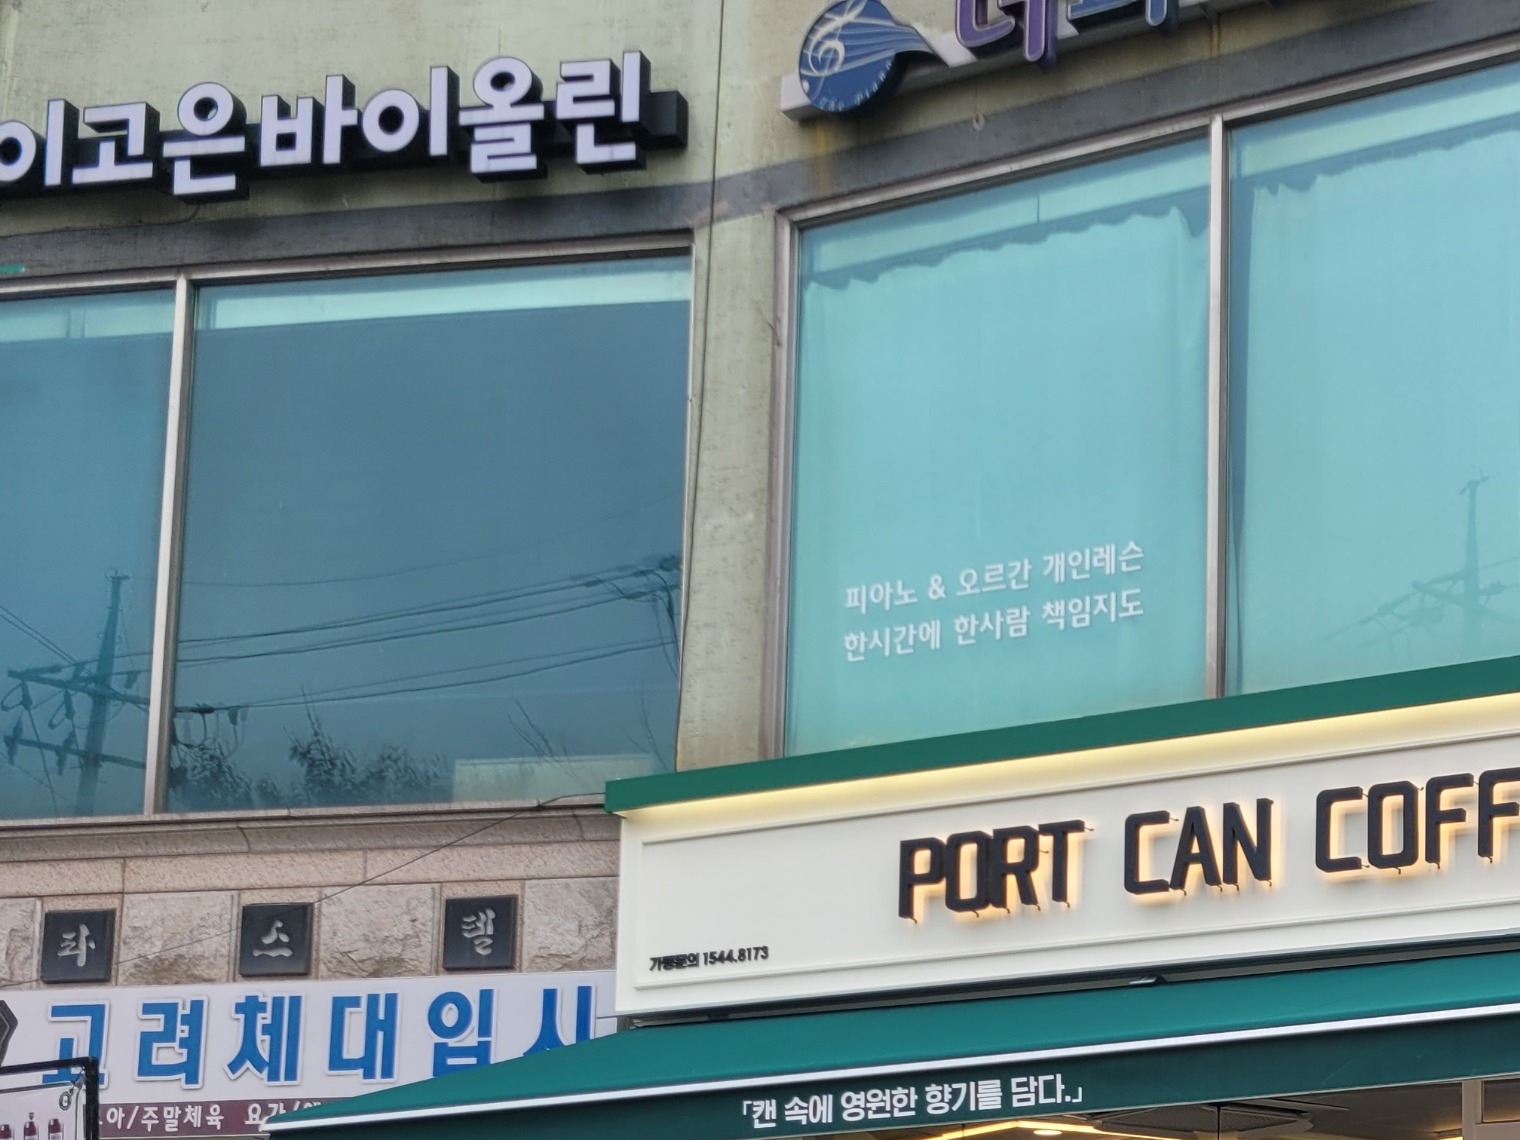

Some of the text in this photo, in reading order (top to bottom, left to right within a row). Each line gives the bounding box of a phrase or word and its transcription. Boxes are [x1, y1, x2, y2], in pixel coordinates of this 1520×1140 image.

[0, 50, 644, 196] 이고은바이올린
[845, 540, 1144, 614] 피아노 & 오르간 개인레슨
[843, 588, 1144, 662] 한시간에 한사람 책임지도
[898, 818, 1086, 921] PORT
[1123, 797, 1275, 895] CAN
[702, 944, 769, 967] 1544.8173
[42, 985, 597, 1086] 고려체대입시
[99, 1104, 224, 1132] 아/주말체육
[784, 1094, 833, 1126] 속에
[839, 1087, 918, 1120] 영원한
[924, 1078, 1003, 1114] 향기를
